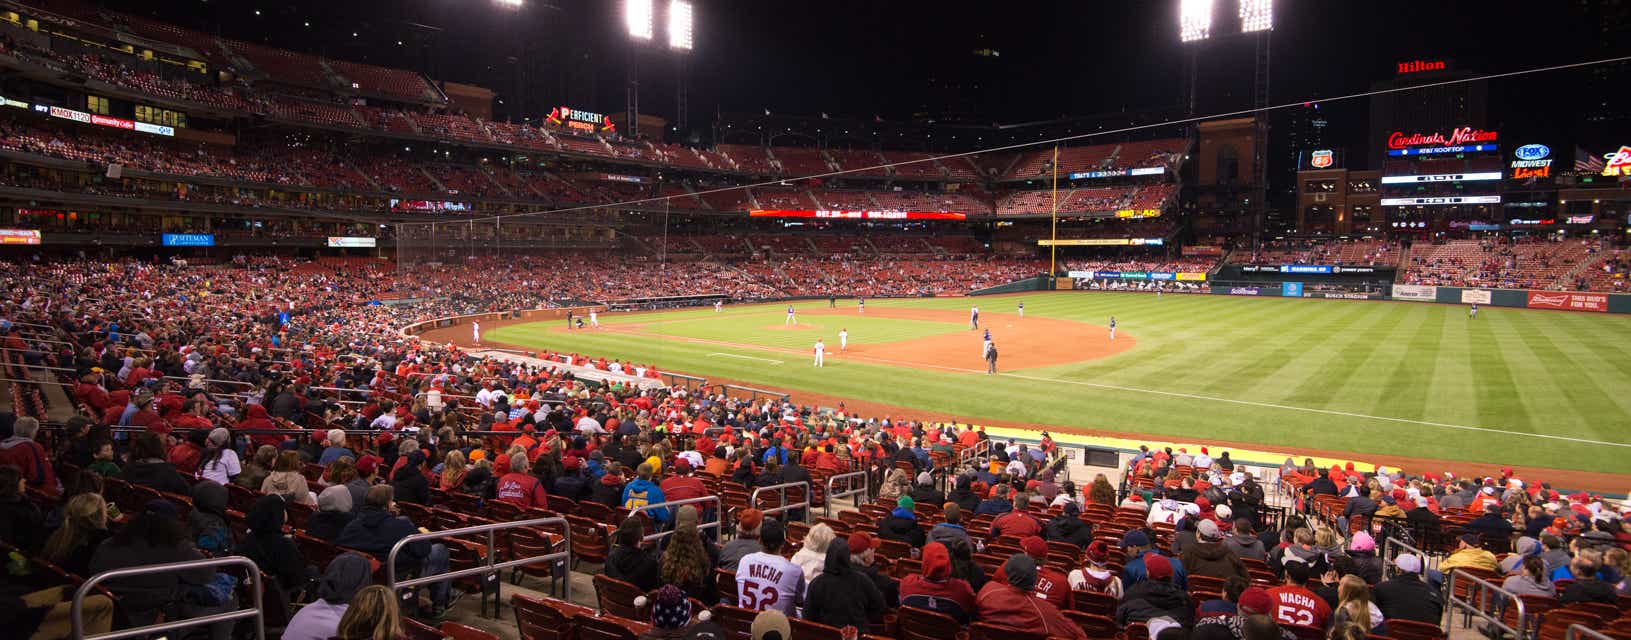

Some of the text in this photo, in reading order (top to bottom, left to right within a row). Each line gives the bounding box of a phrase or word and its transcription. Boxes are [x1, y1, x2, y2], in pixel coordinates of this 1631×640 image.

[1398, 60, 1446, 73] Hilton
[51, 107, 73, 120] KMOX
[71, 111, 91, 123] 1120
[561, 107, 603, 123] PERFICIENT
[568, 120, 594, 131] PERCH
[1388, 127, 1498, 149] Cardinals Nation
[1522, 148, 1542, 158] FOX
[1511, 160, 1553, 169] MIDWEST
[1165, 512, 1175, 524] 4
[748, 563, 783, 585] WACHA
[742, 580, 779, 611] 52
[1279, 592, 1316, 610] WACHA
[1278, 605, 1314, 626] 52
